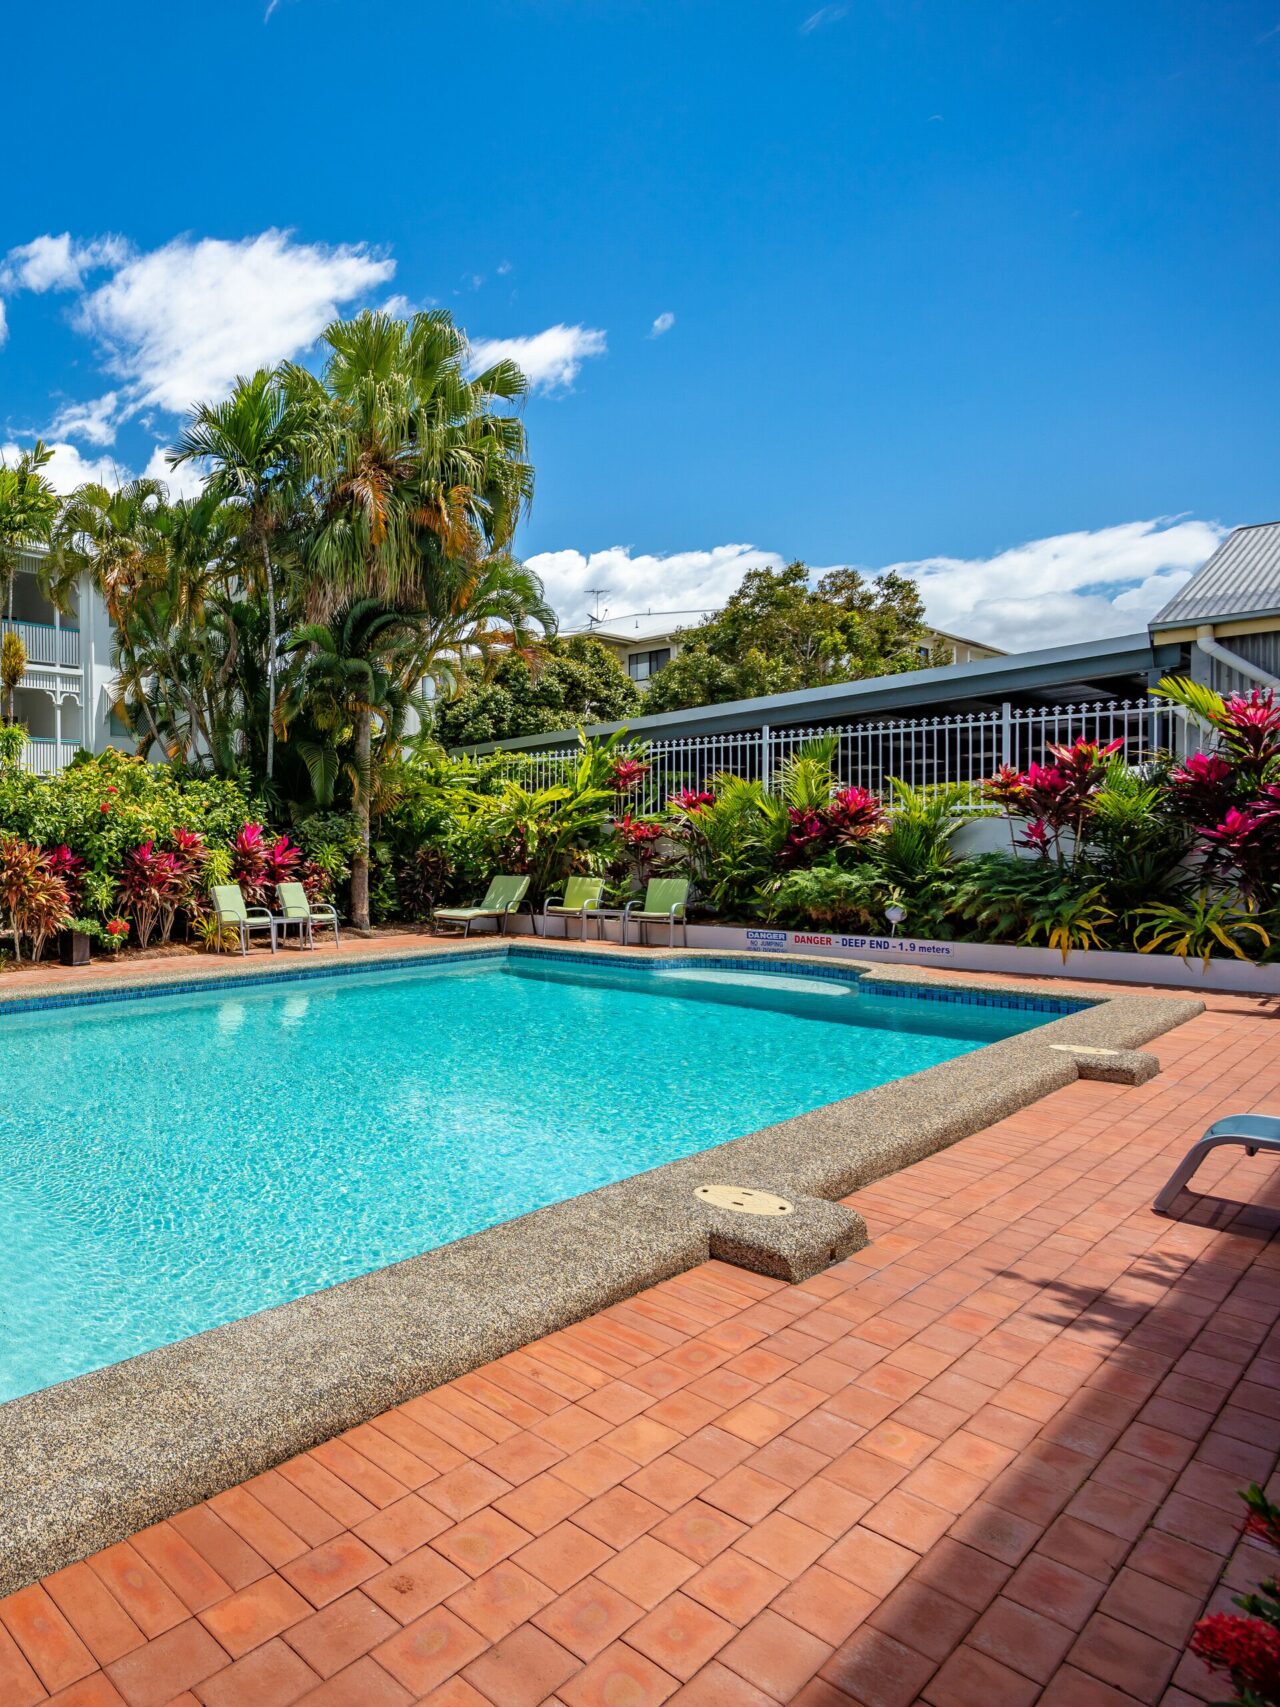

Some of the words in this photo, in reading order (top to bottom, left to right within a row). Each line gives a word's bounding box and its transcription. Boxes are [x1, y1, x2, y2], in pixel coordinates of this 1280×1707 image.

[748, 932, 786, 940] DANGER
[794, 935, 832, 946] DANGER
[841, 938, 866, 948] DEEP
[869, 940, 890, 950] END
[898, 942, 916, 952] 1.9
[918, 945, 951, 954] meters
